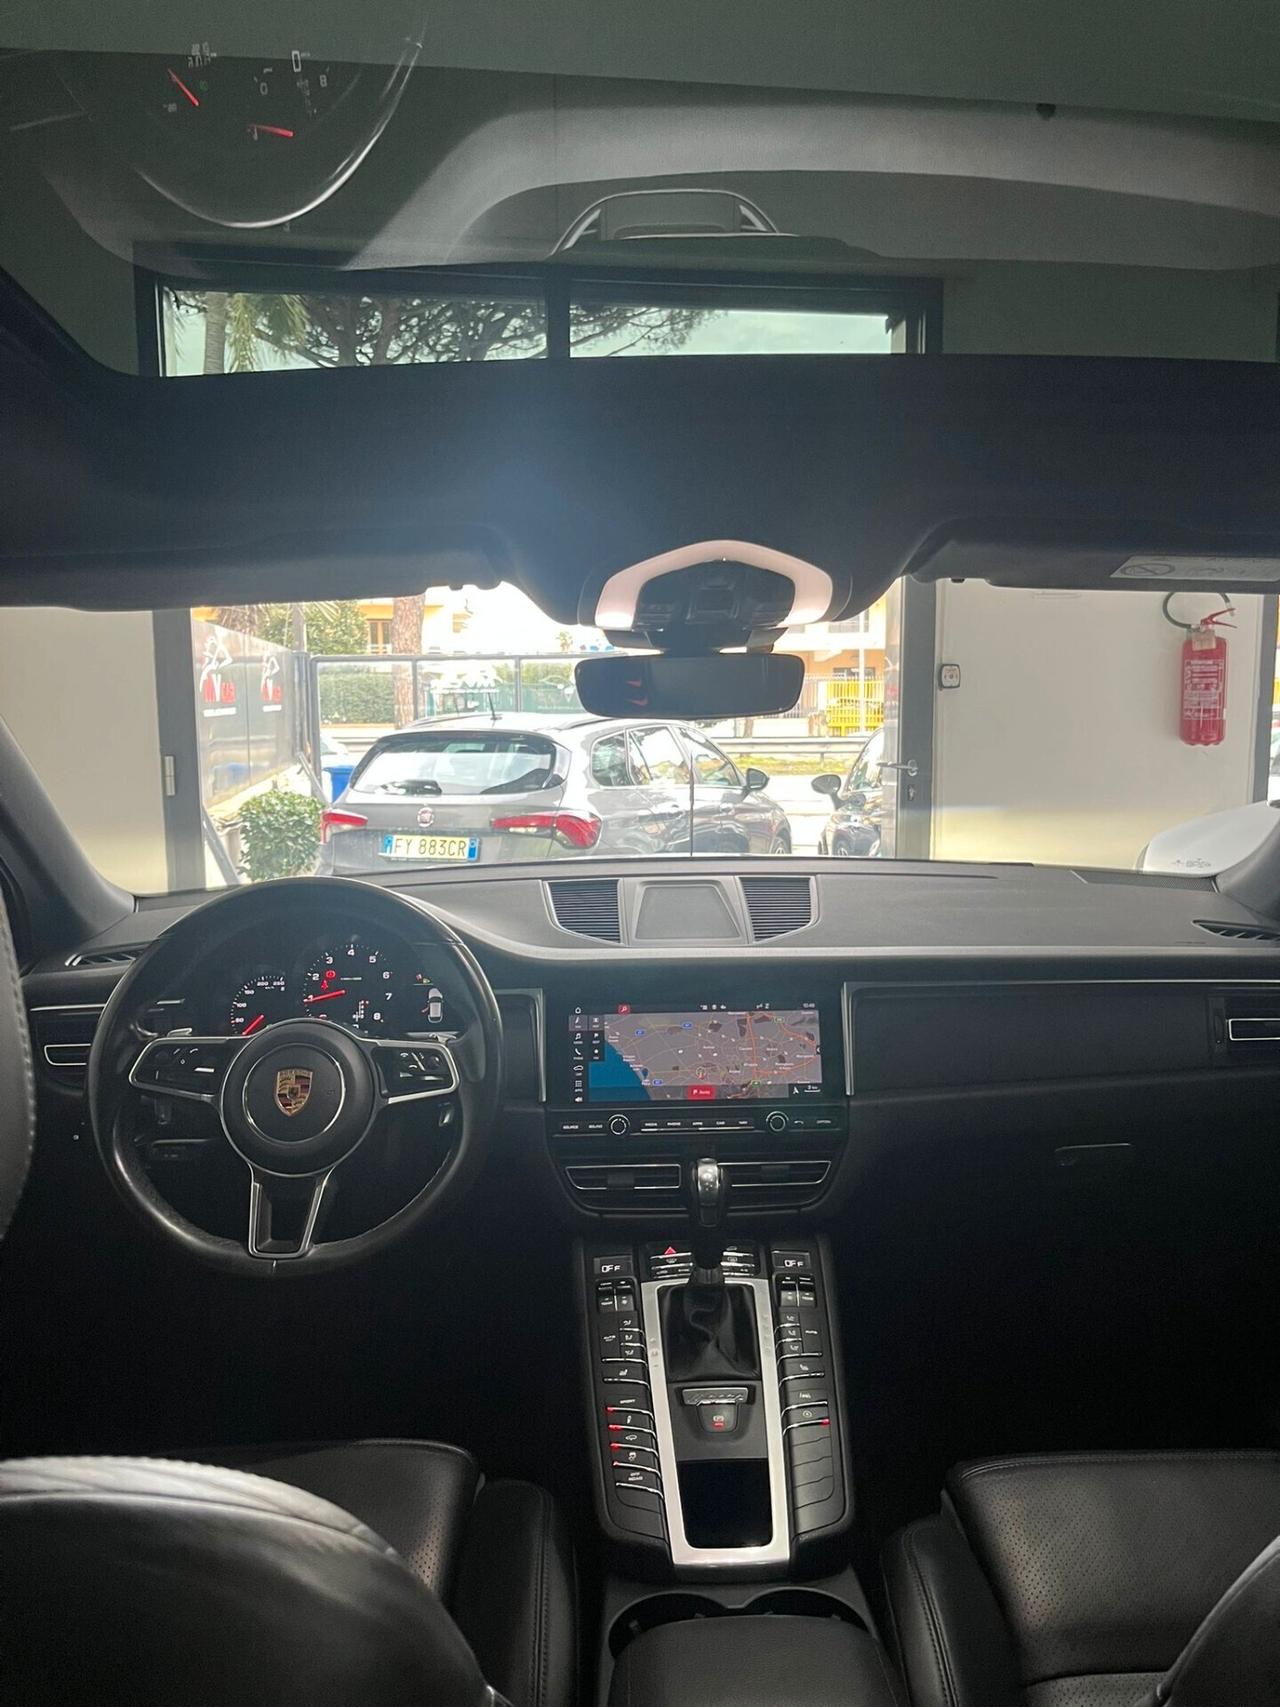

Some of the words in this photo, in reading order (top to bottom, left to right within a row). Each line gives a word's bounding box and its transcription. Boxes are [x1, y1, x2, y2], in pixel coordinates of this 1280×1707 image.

[394, 838, 413, 855] FY
[418, 838, 467, 857] 883CR
[325, 956, 334, 964] 3
[369, 955, 377, 963] 5
[312, 973, 320, 981] 2
[382, 971, 390, 979] 6
[373, 1012, 381, 1020] 8
[784, 1259, 804, 1267] OFF
[601, 1264, 621, 1273] OFF
